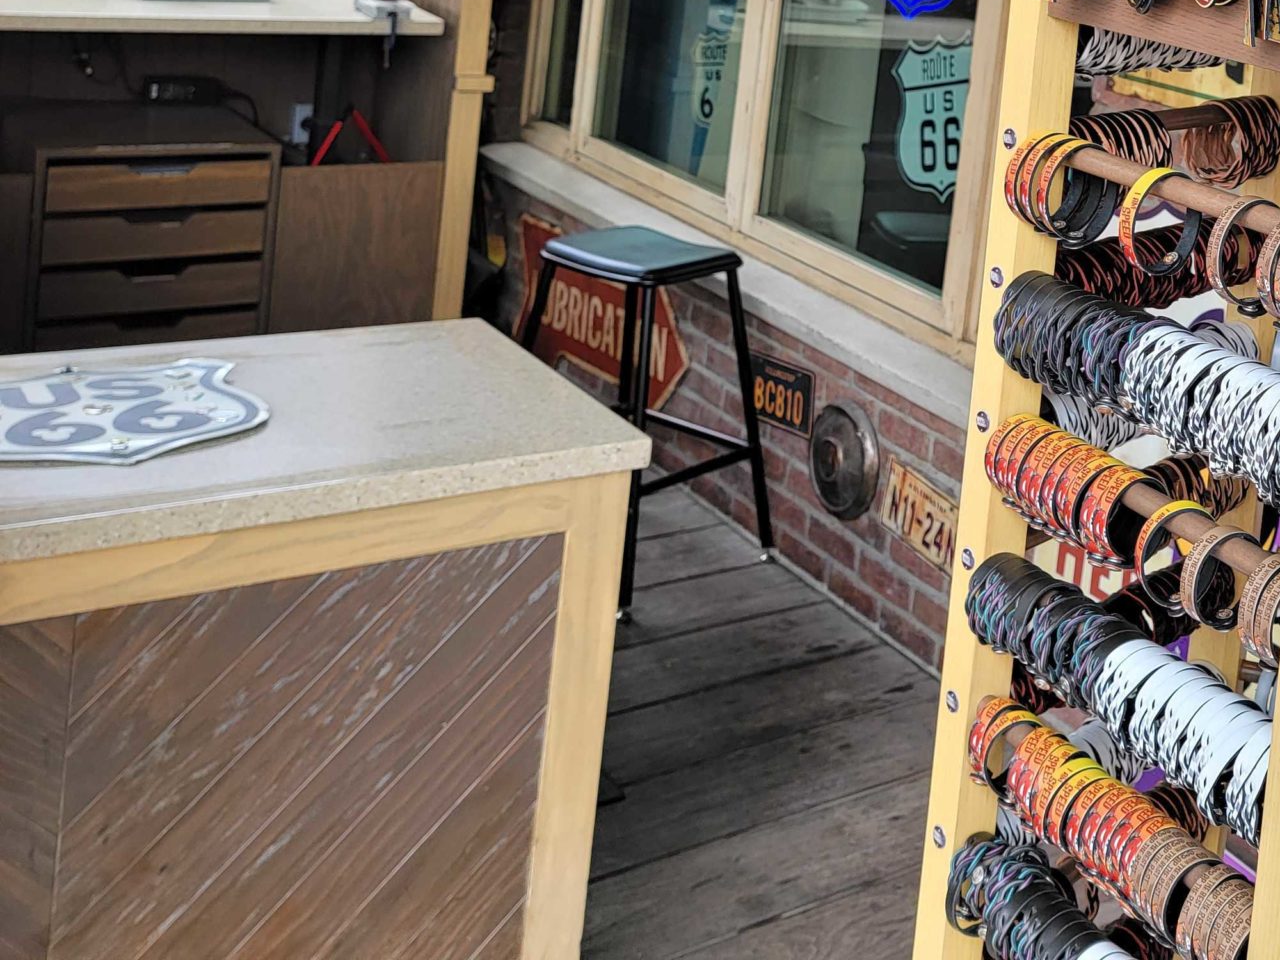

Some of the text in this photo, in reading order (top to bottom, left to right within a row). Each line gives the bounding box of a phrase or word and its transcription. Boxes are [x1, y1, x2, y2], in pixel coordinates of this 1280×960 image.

[923, 52, 956, 80] ROUTE
[923, 90, 954, 114] US
[920, 116, 960, 172] 66
[1121, 207, 1131, 239] SPEED
[530, 270, 668, 382] UBRICATN
[5, 399, 212, 446] 66
[1040, 777, 1057, 809] SPEED
[1055, 784, 1074, 816] SPEED
